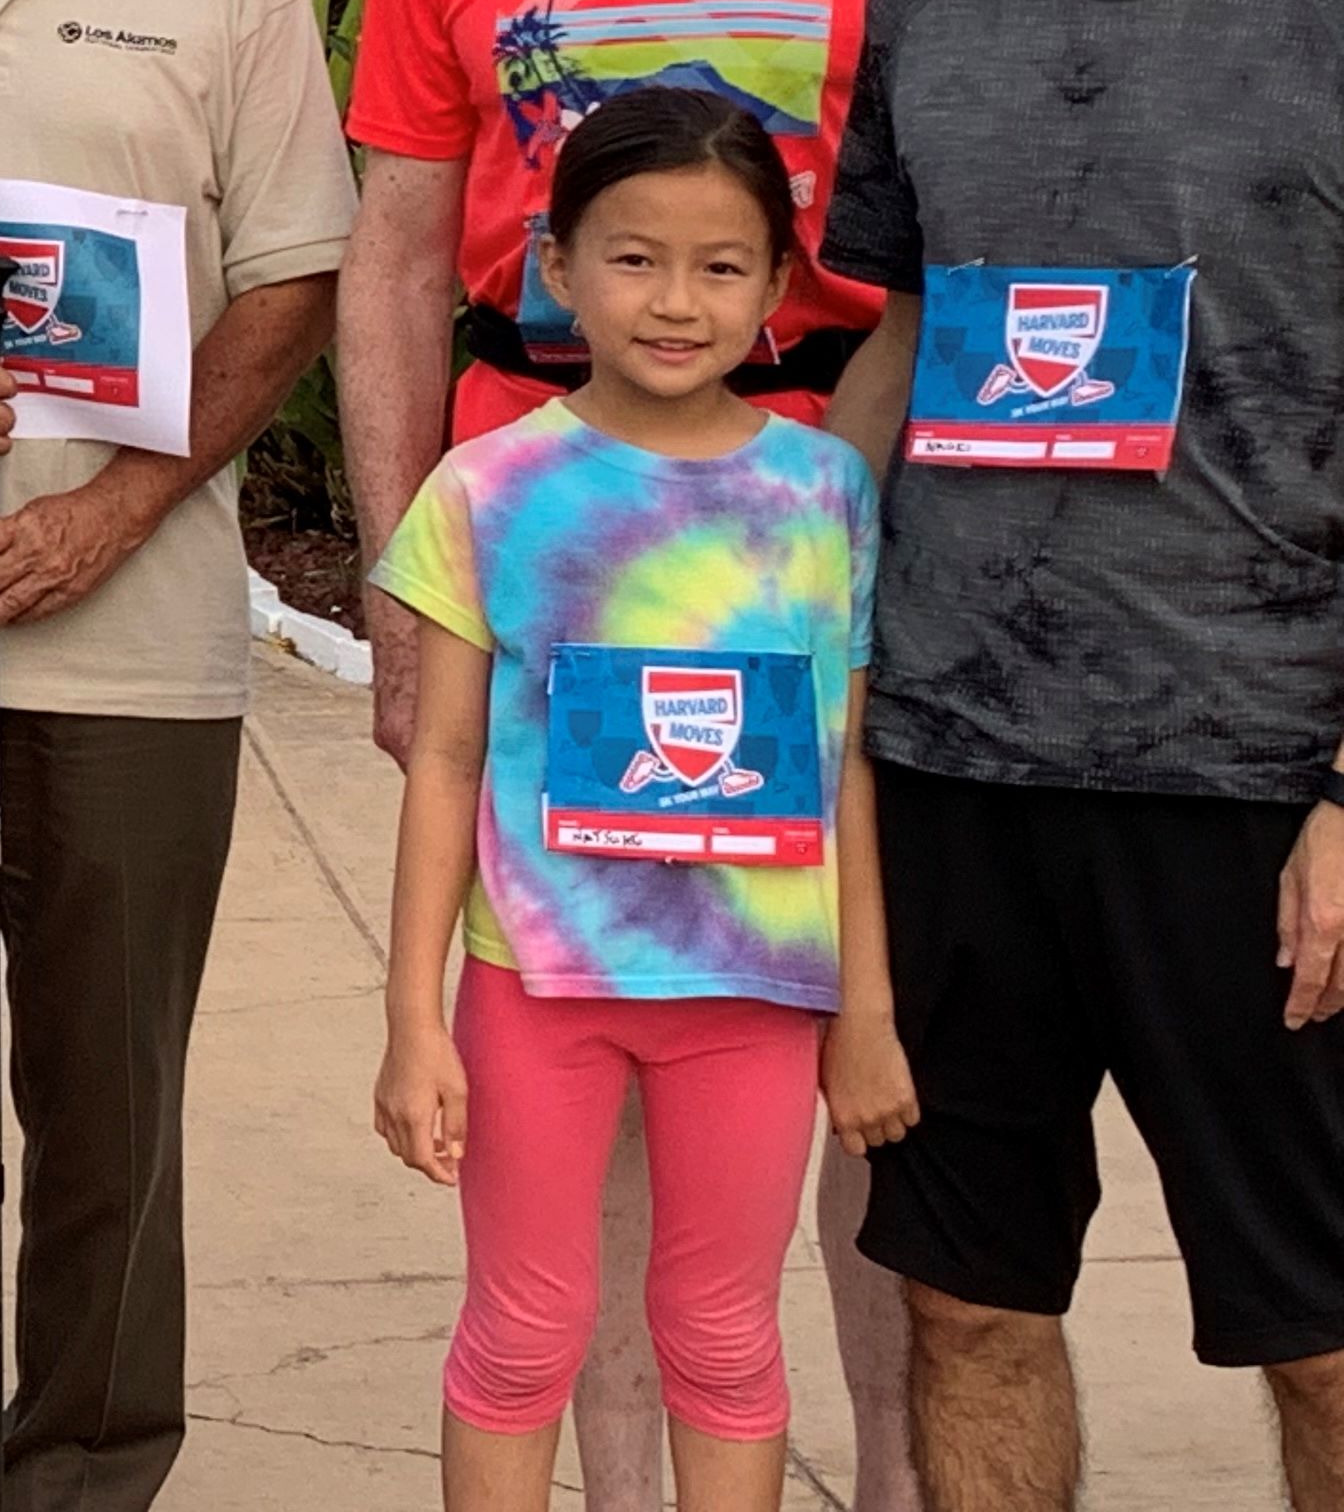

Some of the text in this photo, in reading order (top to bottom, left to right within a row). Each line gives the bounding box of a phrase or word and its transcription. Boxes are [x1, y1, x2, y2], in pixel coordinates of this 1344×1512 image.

[85, 25, 113, 40] Los
[115, 30, 178, 49] Alamos
[1017, 312, 1089, 333] HARVARD
[1028, 336, 1082, 360] MOVES
[654, 696, 728, 718] HARVARD
[669, 721, 724, 747] MOVES
